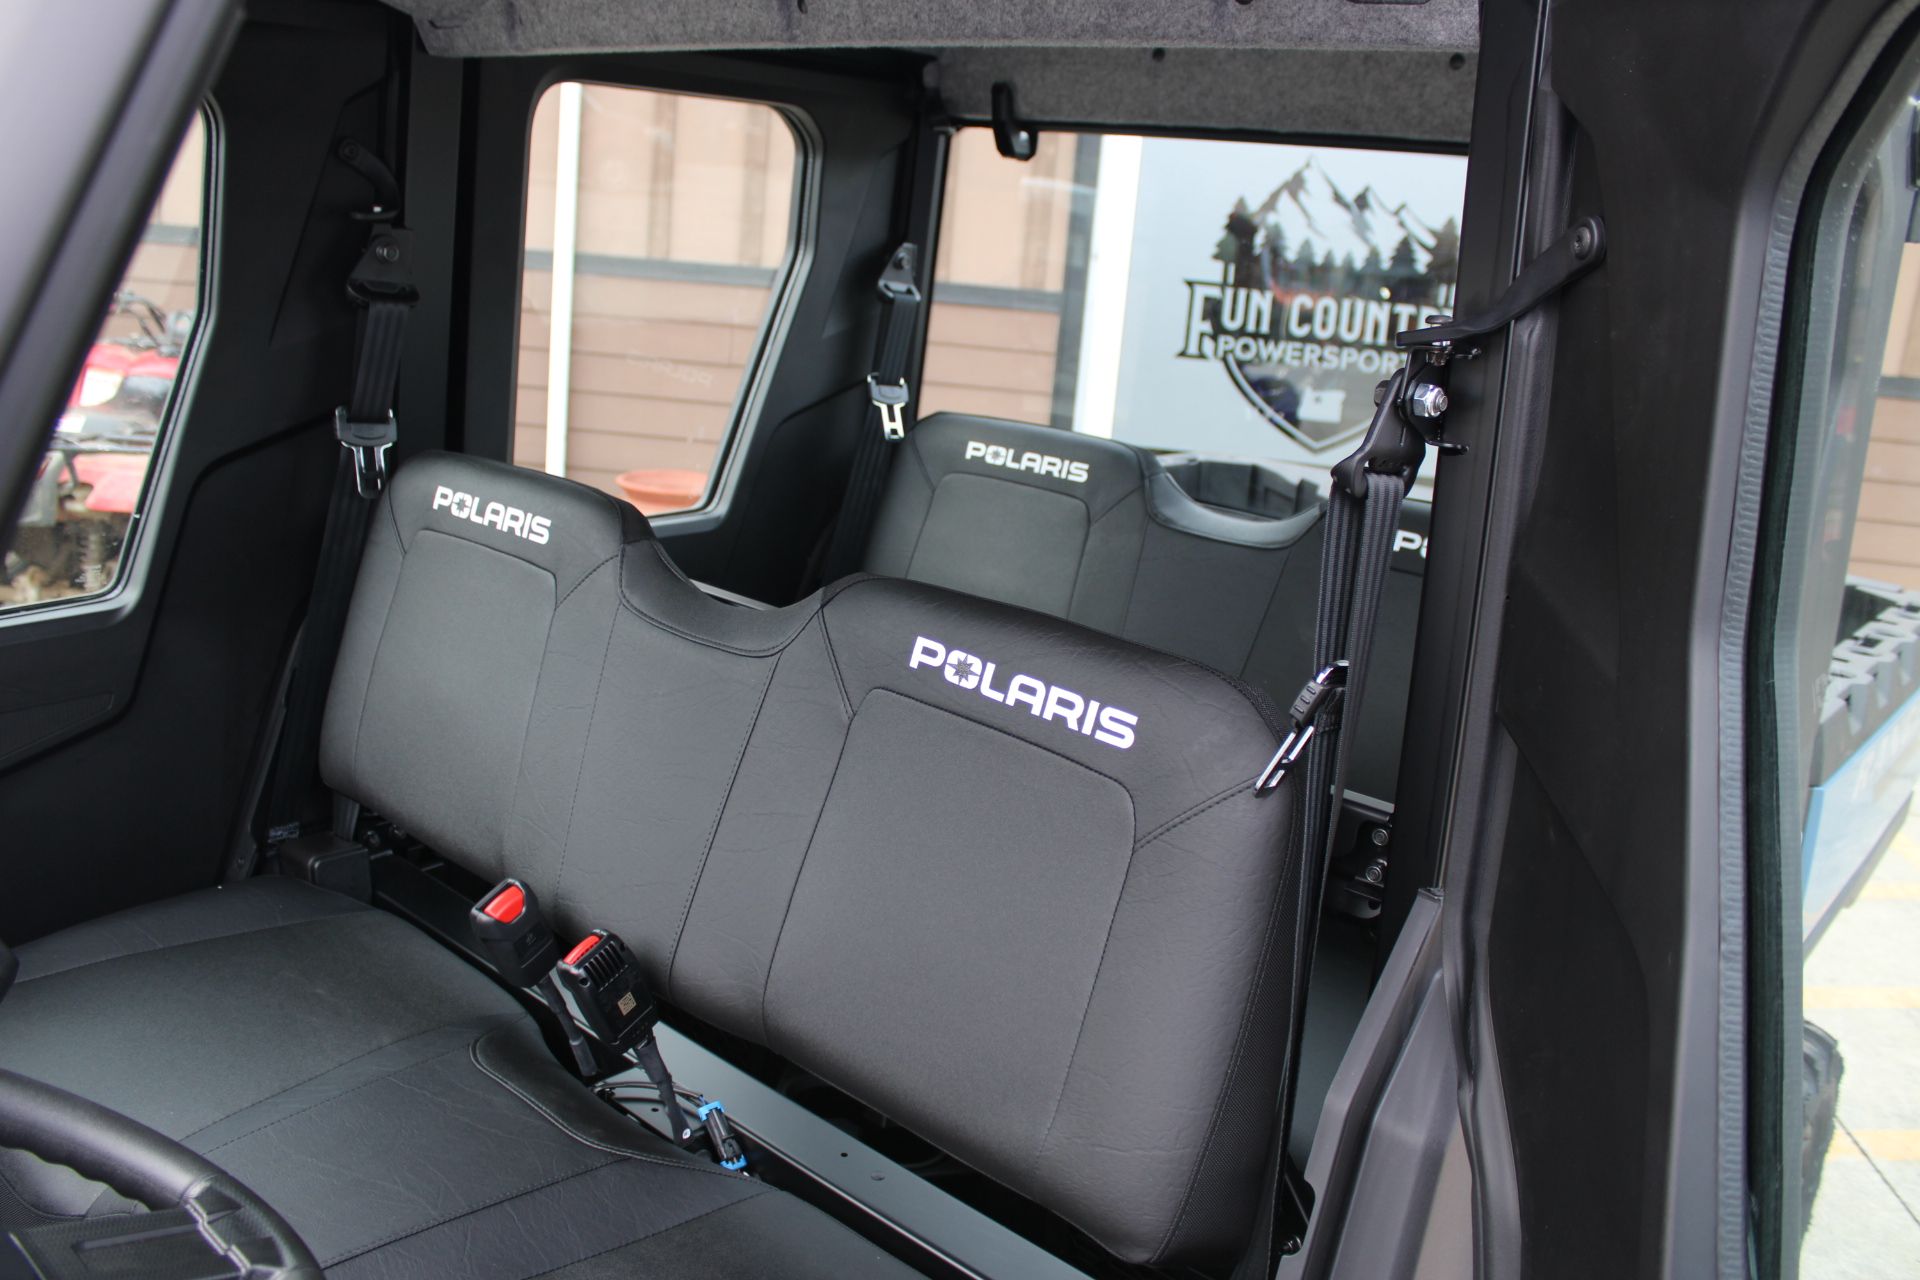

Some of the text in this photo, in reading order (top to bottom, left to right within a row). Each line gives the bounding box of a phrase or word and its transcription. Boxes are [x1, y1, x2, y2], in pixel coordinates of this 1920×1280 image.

[1176, 278, 1274, 358] FUN
[965, 440, 1090, 483] POLARIS
[432, 485, 552, 545] POLARIS
[909, 635, 1139, 749] POLARIS
